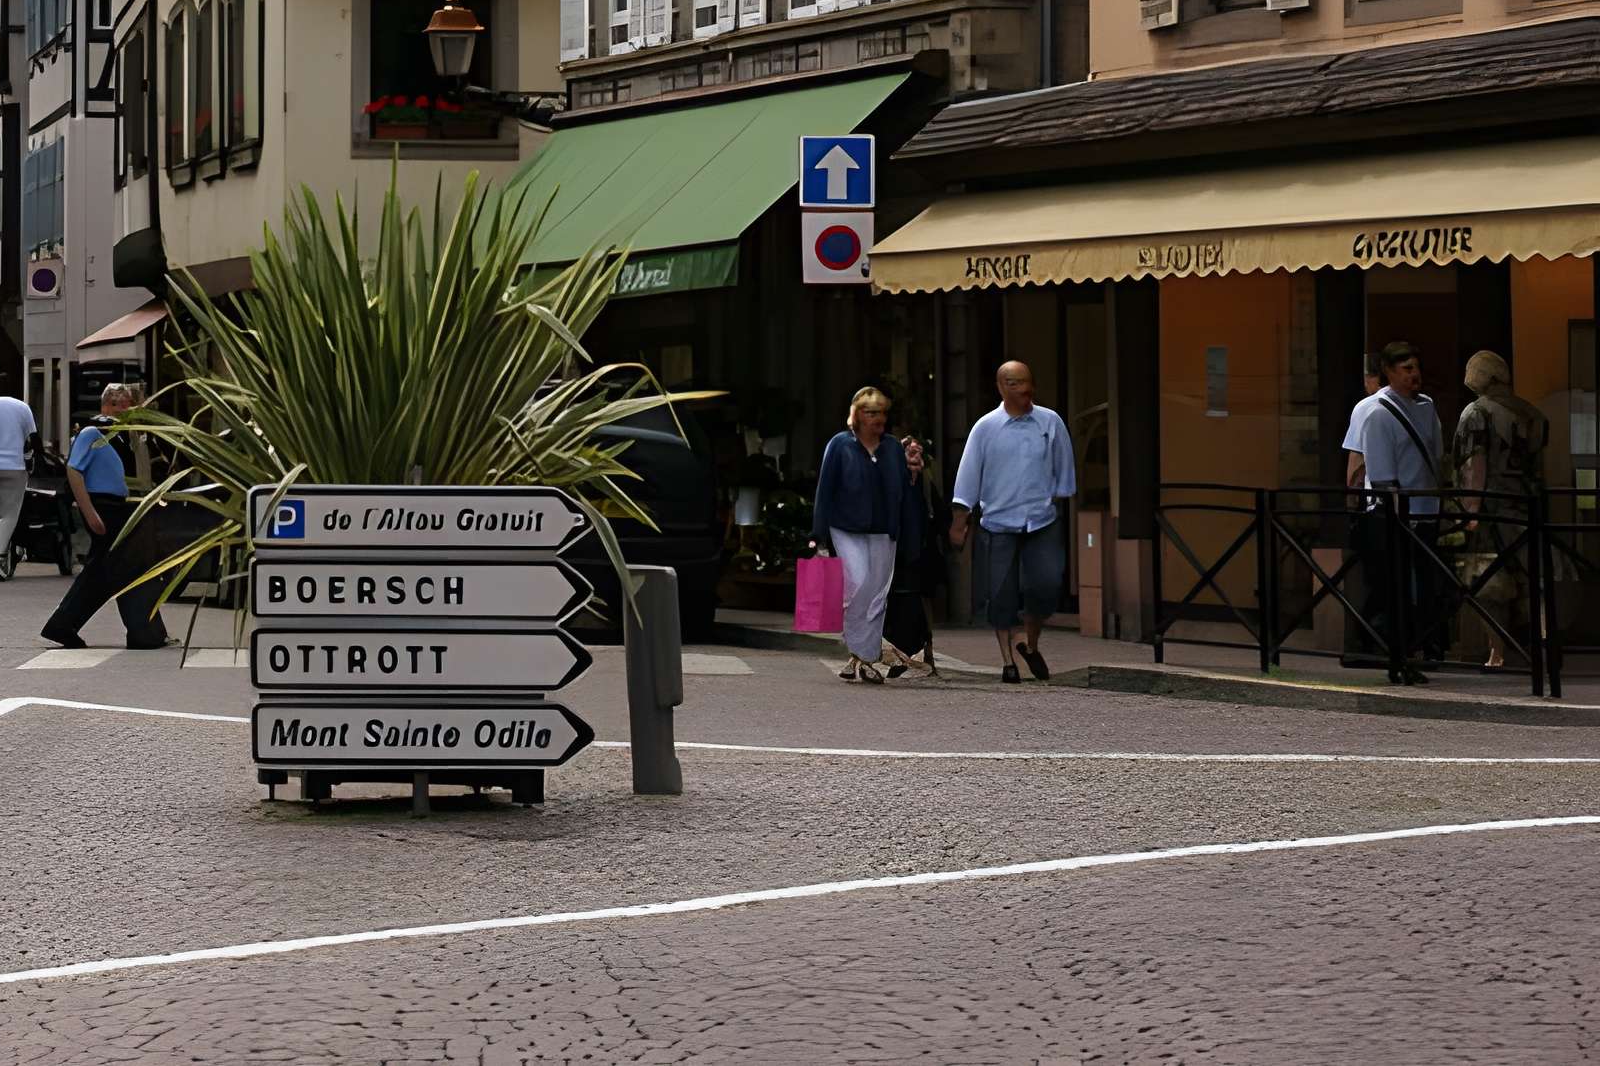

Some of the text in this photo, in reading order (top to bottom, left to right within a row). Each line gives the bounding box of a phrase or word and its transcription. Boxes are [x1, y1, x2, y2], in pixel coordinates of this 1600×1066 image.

[272, 505, 297, 535] P
[268, 575, 465, 605] BOERSCH
[269, 644, 448, 675] OTTROTT
[270, 718, 552, 749] Mont Sainte Odile
